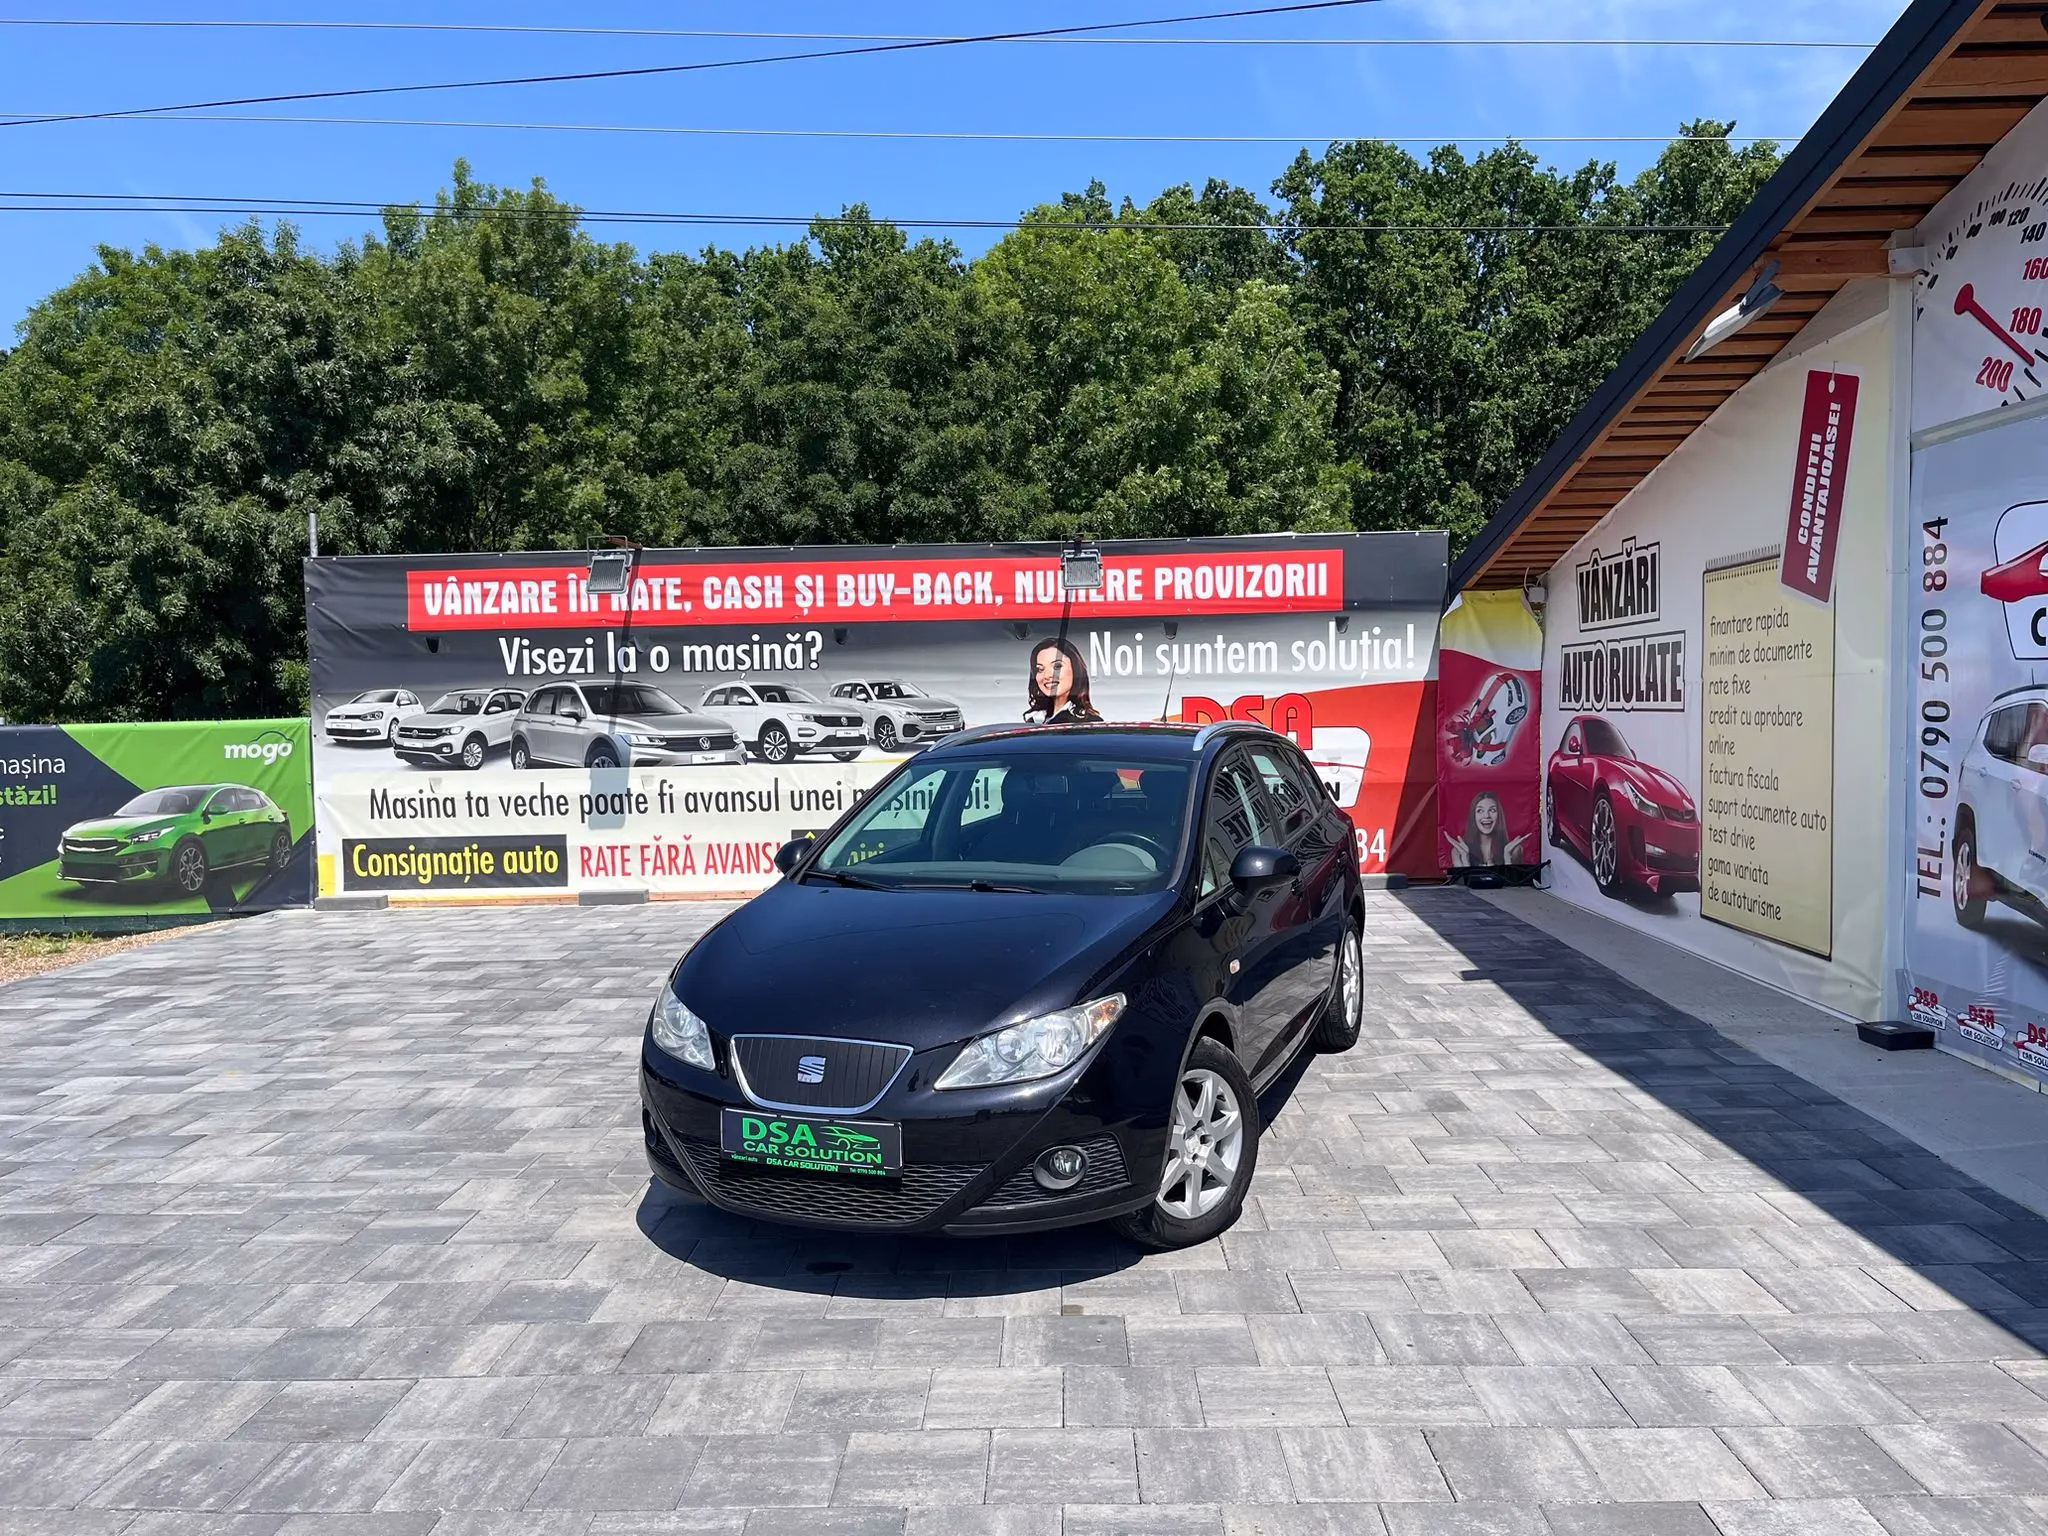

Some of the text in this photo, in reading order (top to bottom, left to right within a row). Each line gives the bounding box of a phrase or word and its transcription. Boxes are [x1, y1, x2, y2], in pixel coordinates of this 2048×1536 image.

[2007, 206, 2030, 227] 120
[2020, 222, 2047, 244] 140
[2023, 257, 2048, 280] 160
[2009, 307, 2042, 335] 180
[1975, 356, 2014, 392] 200
[1806, 402, 1841, 584] AVANTAJOASE!
[1922, 516, 1948, 592] 884
[423, 576, 557, 615] VÂNZARE
[611, 577, 692, 613] RATE,
[703, 575, 783, 610] CASH
[795, 573, 825, 616] ȘI
[836, 571, 1003, 607] BUY-BACK,
[1155, 562, 1327, 599] PROVIZORII
[1579, 546, 1657, 624] VÂNZĂRI
[1710, 606, 1789, 637] finantare rapida
[498, 630, 824, 680] Visezi la o mașină?
[1090, 621, 1416, 680] Noi suntem soluția!
[1709, 640, 1813, 666] minim de documente
[1921, 608, 1949, 683] 500
[1709, 673, 1751, 695] rate fixe
[1709, 704, 1804, 732] credit cu aprobare
[224, 741, 294, 765] mogo
[1708, 734, 1736, 755] online
[1920, 700, 1950, 799] 0790
[1709, 763, 1779, 792] factura fiscala
[464, 790, 490, 818] ta
[499, 781, 570, 818] veche
[580, 787, 649, 824] poate
[657, 779, 675, 814] fi
[684, 777, 780, 814] avansul
[790, 780, 842, 812] unei
[1708, 797, 1827, 832] suport documente auto
[1708, 824, 1756, 851] test drive
[352, 843, 559, 885] Consignație auto
[580, 845, 632, 877] RATE
[640, 834, 696, 877] FĂRĂ
[1708, 857, 1769, 886] gama variata
[1708, 881, 1782, 921] de autoturisme
[742, 1116, 818, 1147] DSA
[743, 1140, 882, 1164] CAR SOLUTION
[766, 1157, 839, 1172] DSA CAR SOLUTION
